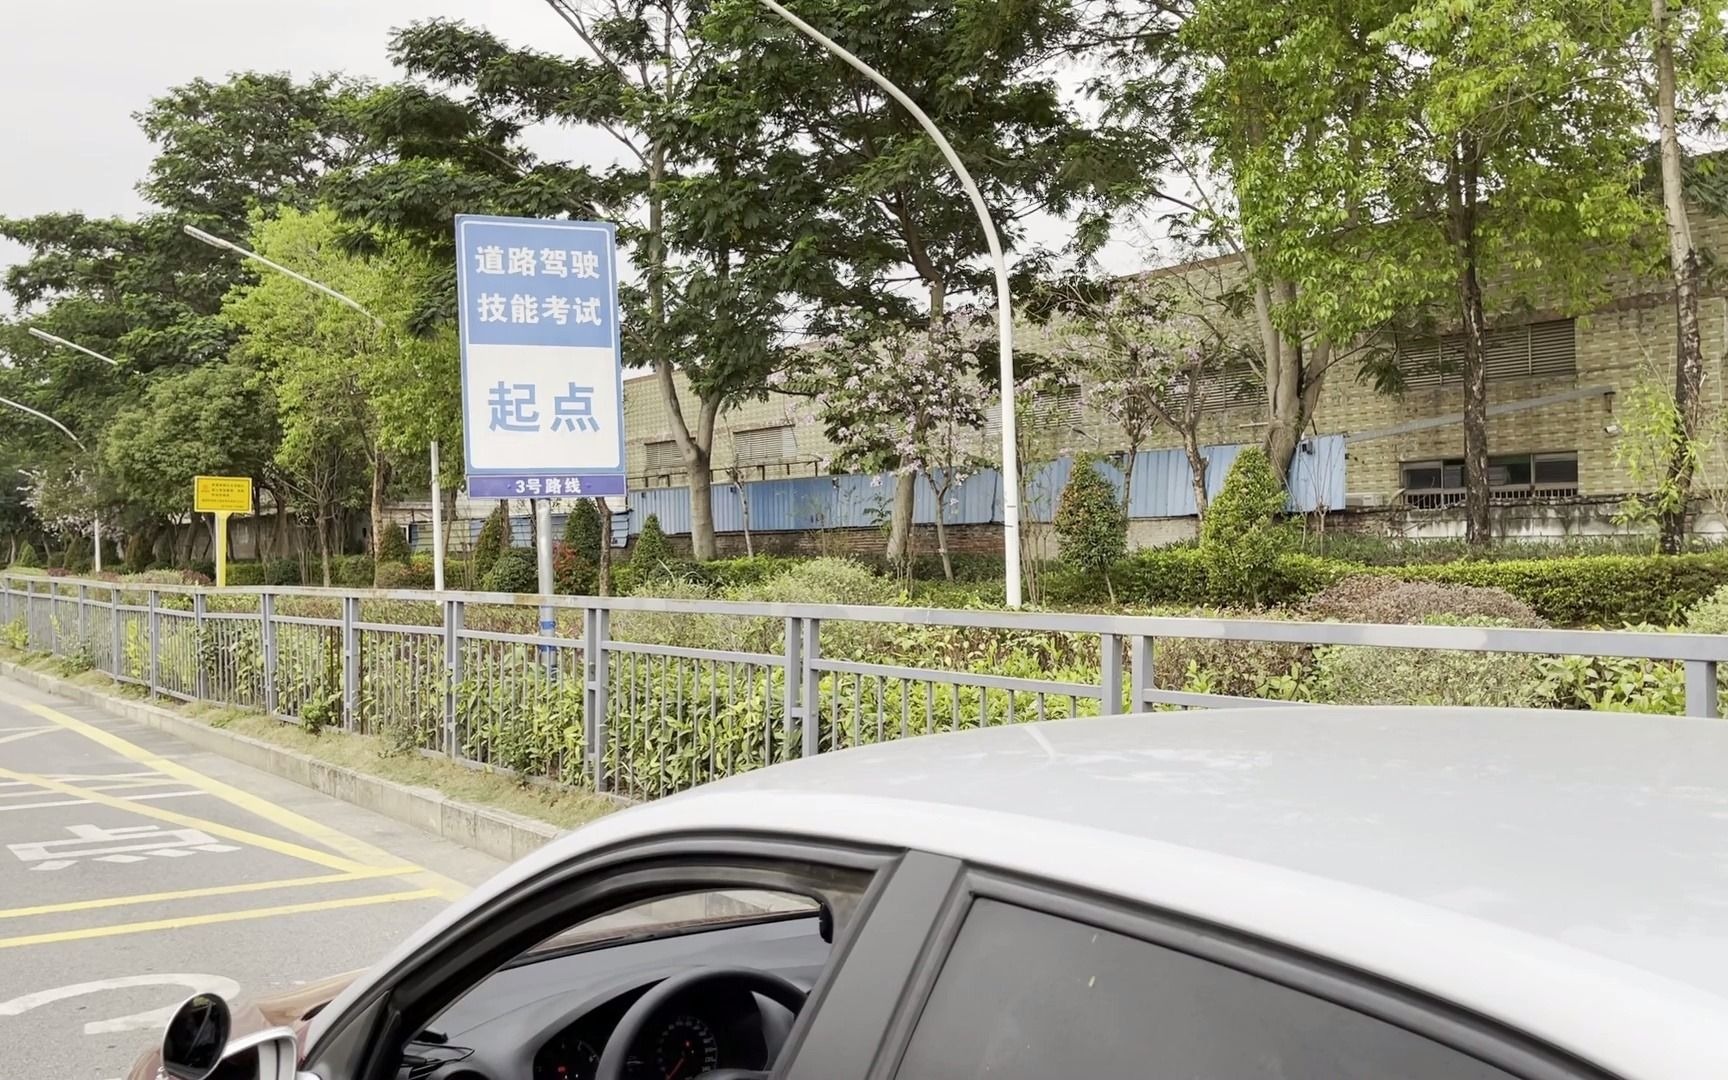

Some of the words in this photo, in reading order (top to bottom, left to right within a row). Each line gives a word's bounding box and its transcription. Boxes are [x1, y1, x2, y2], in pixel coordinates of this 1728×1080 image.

[475, 245, 600, 280] 道路驾驶
[478, 292, 602, 327] 技能考试
[488, 380, 601, 433] 起点
[515, 477, 582, 495] 3号路线
